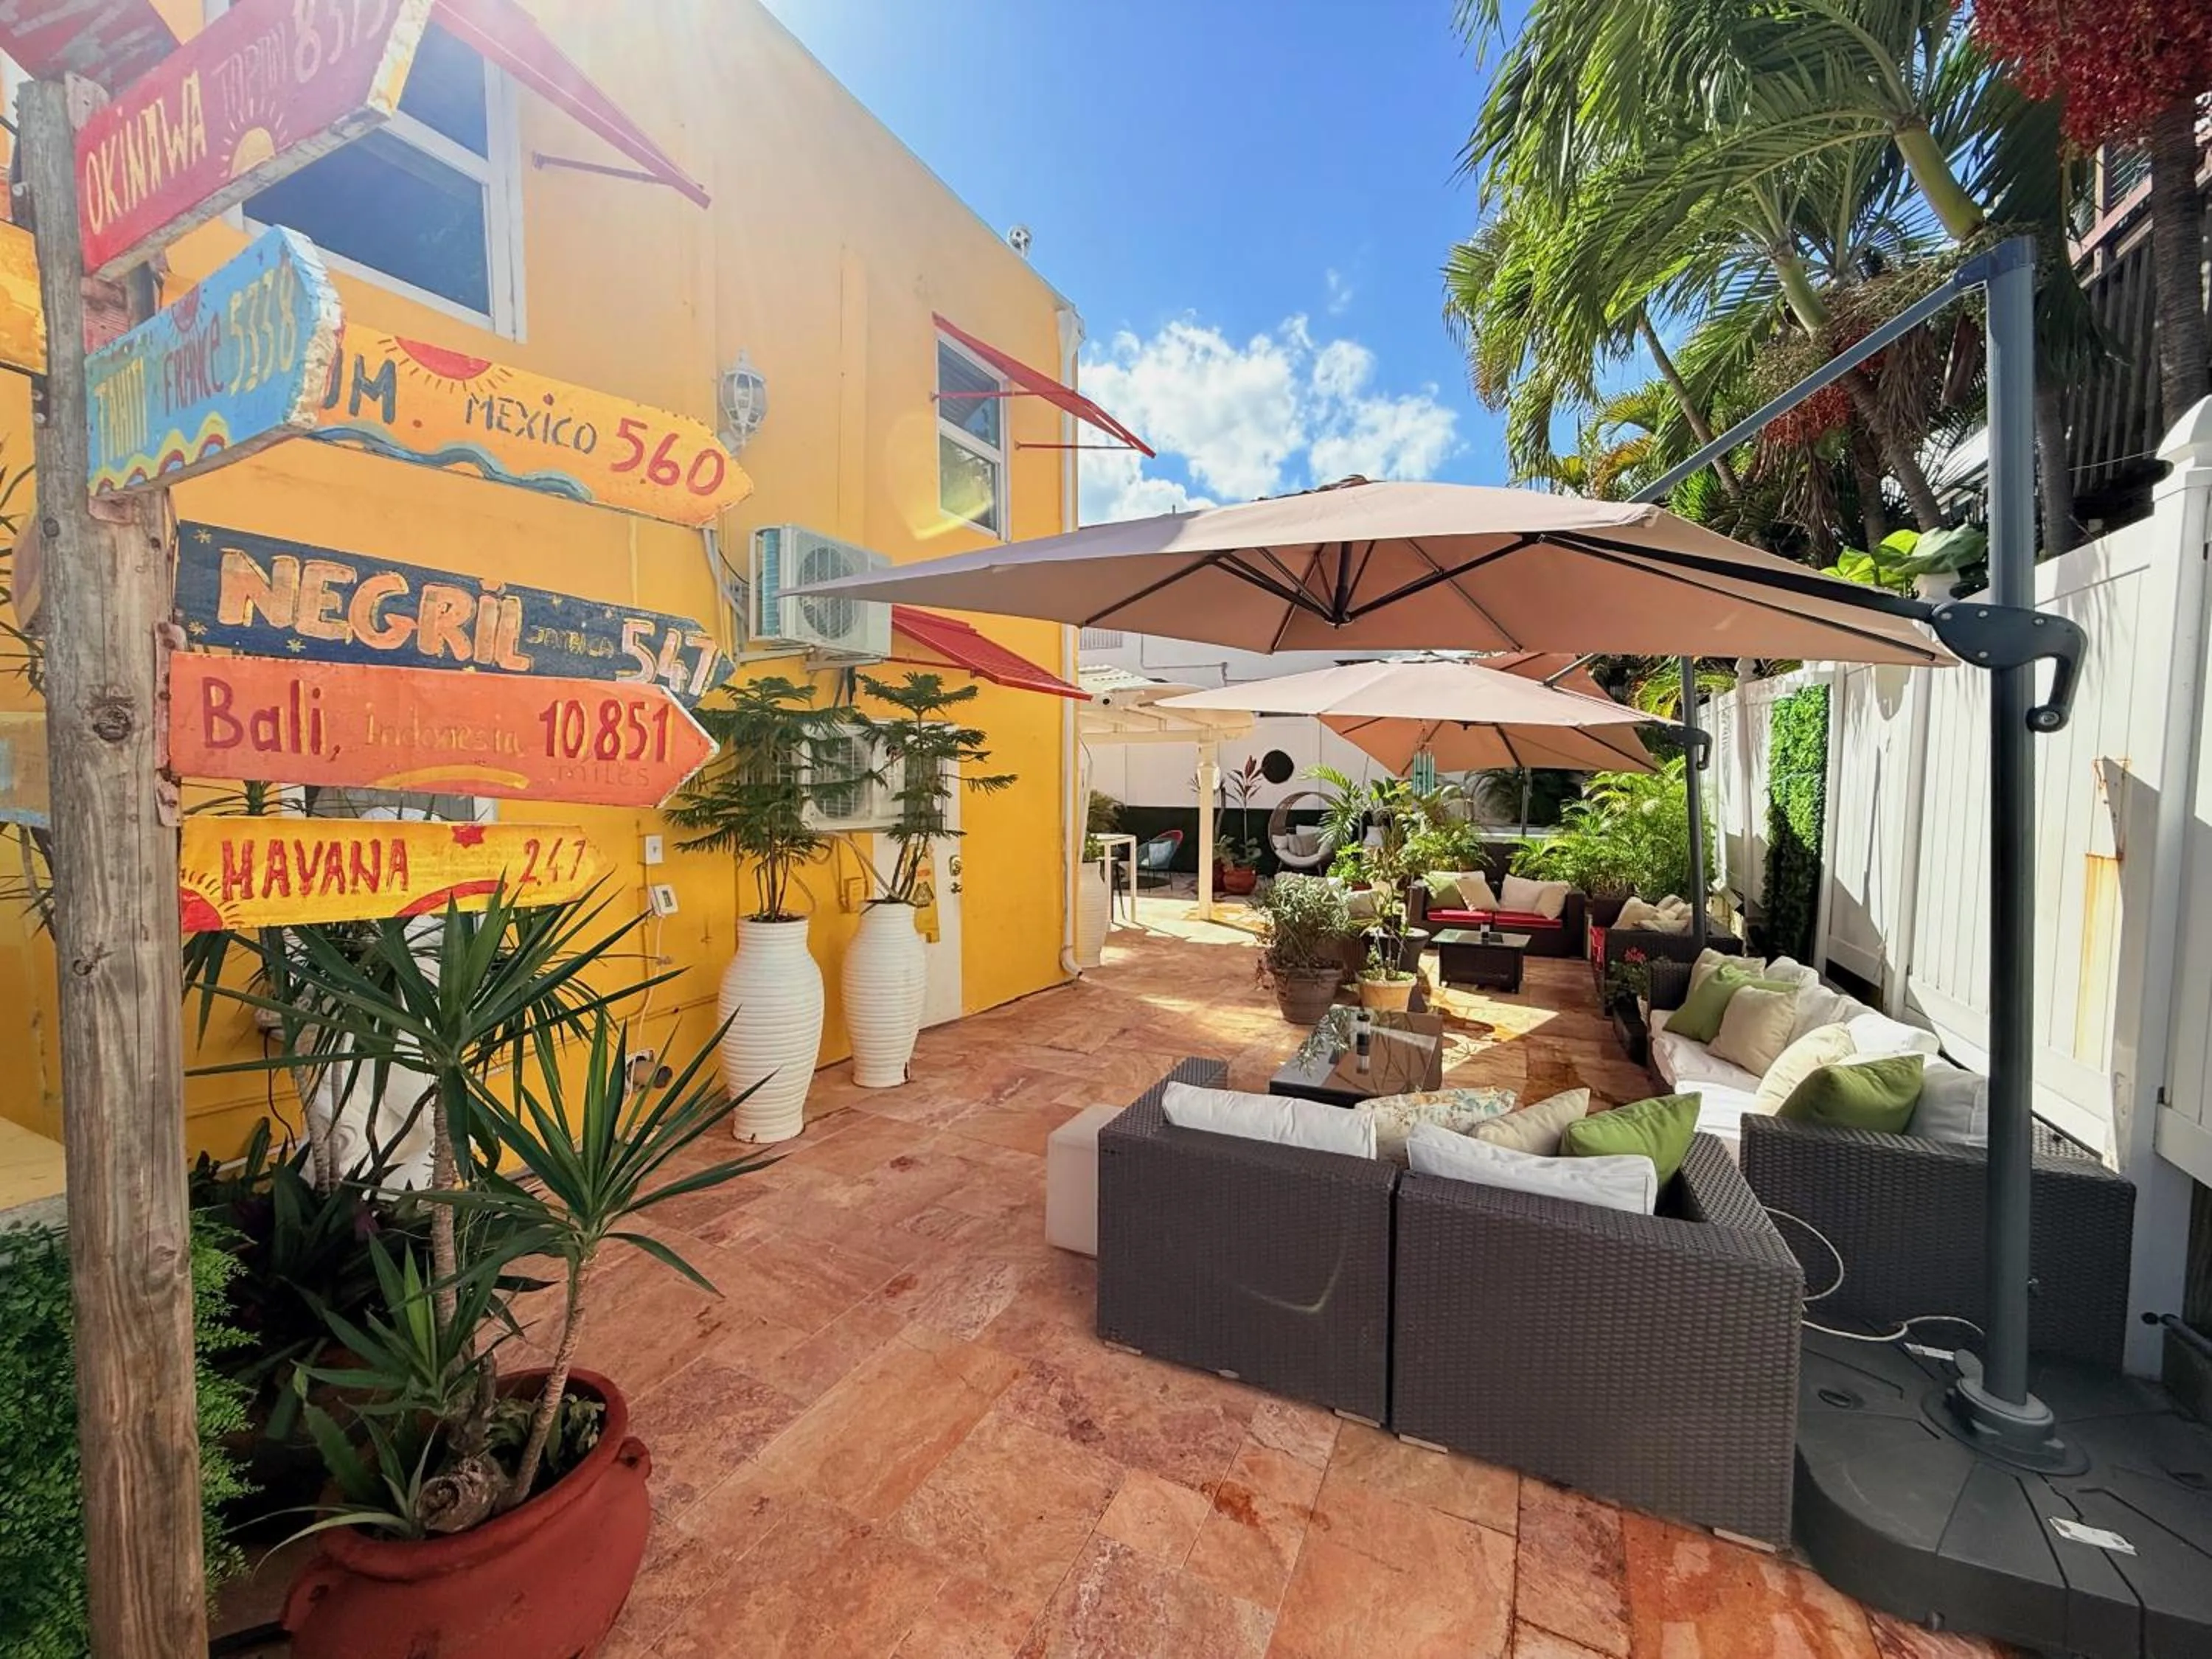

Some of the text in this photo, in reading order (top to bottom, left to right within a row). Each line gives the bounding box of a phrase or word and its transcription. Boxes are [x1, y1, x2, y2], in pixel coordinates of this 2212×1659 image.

[86, 71, 207, 235] OKINAWA
[465, 392, 598, 455] MEXICO
[217, 548, 535, 672] NEGRIL
[616, 617, 723, 698] 547
[202, 676, 341, 762] Bali,
[221, 837, 411, 902] HAVANA
